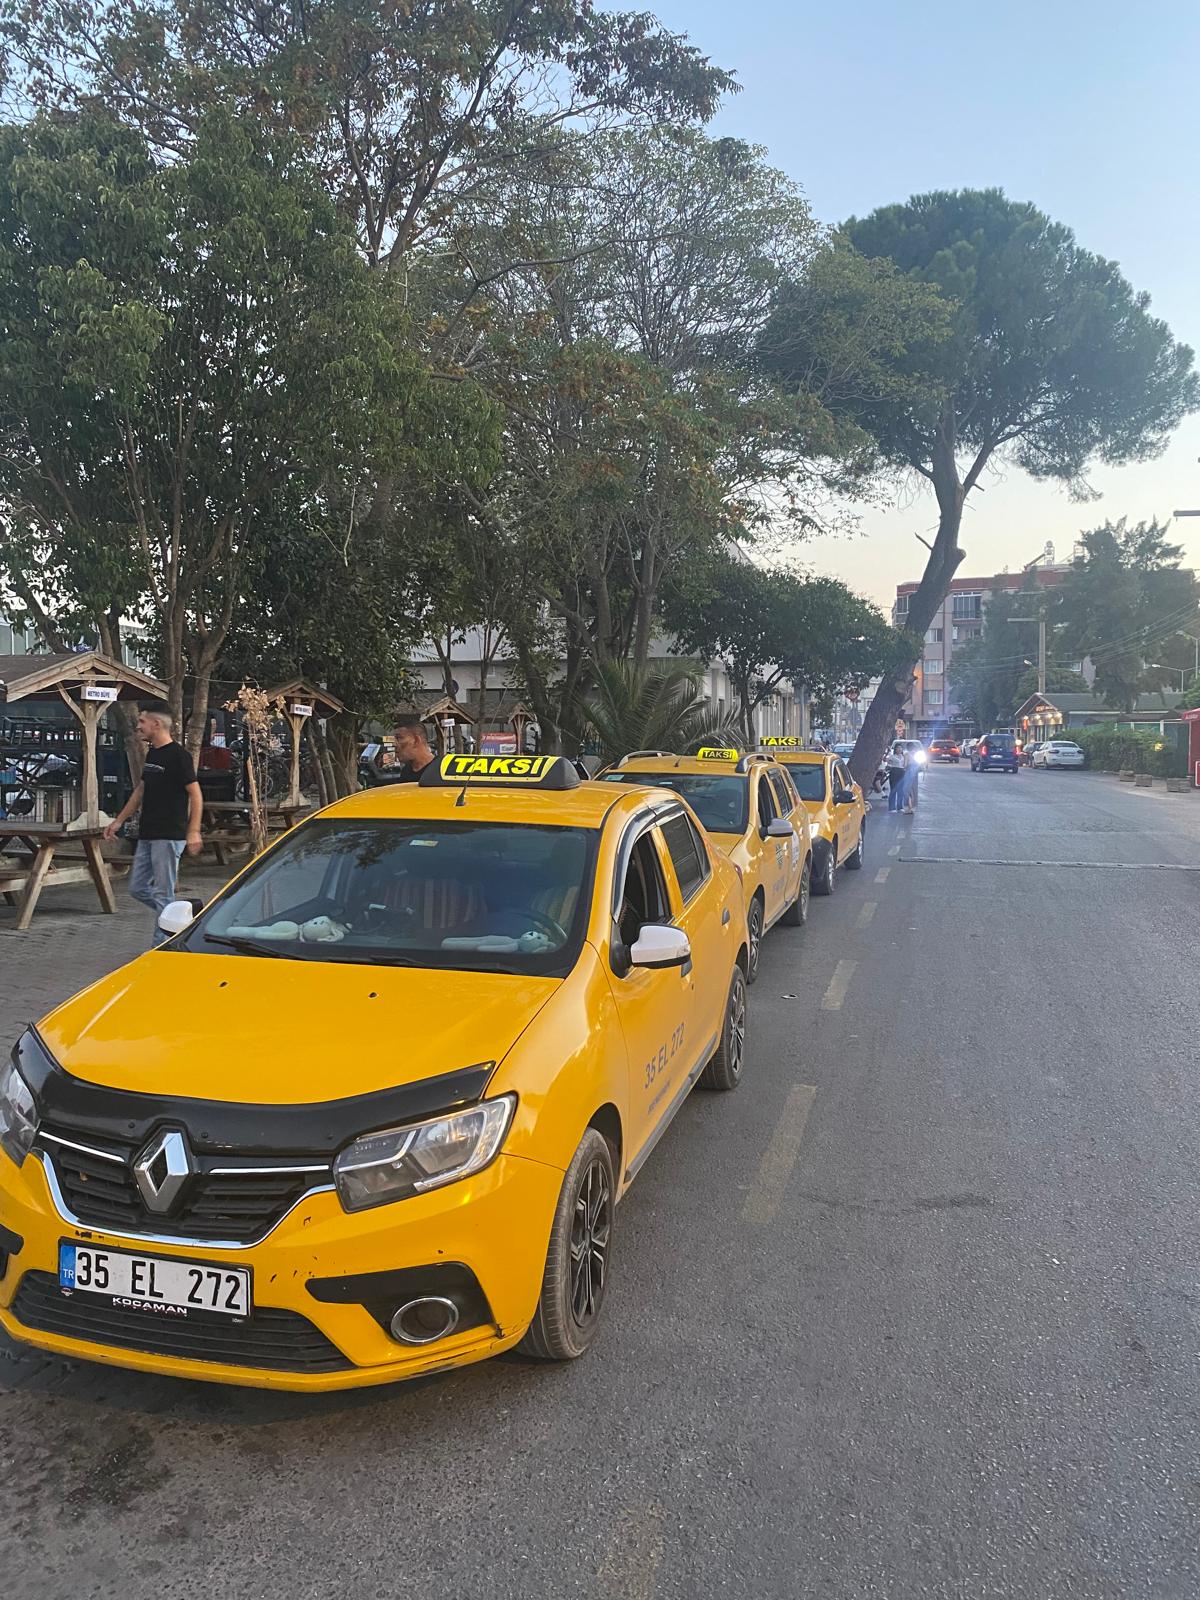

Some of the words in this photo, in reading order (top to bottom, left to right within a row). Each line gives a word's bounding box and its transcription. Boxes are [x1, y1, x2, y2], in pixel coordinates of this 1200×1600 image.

[645, 1055, 656, 1089] 35
[658, 1043, 668, 1073] EL
[671, 1021, 685, 1058] 272
[63, 1268, 74, 1279] TR
[76, 1251, 109, 1289] 35
[131, 1260, 164, 1298] EL
[187, 1269, 241, 1310] 272
[112, 1297, 188, 1315] KOCAMAN
